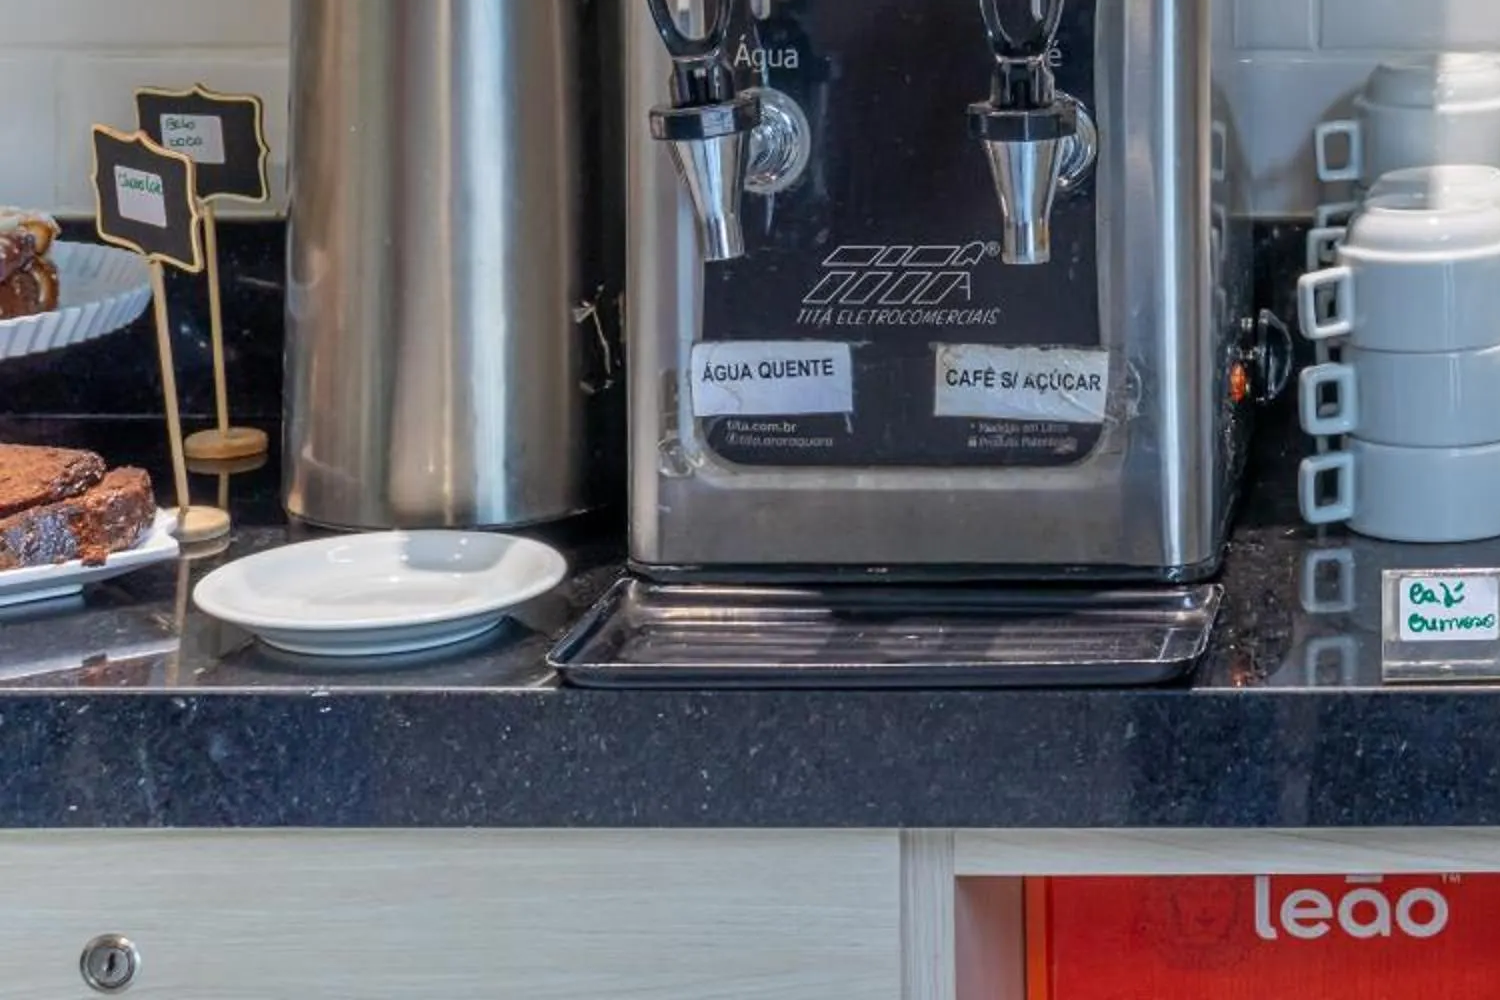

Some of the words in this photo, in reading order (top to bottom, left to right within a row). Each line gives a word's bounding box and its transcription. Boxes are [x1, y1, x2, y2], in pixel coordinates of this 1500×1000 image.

[733, 34, 799, 73] Água
[835, 307, 1001, 326] ELETROCOMERCIAIS
[702, 360, 753, 383] ÁGUA
[757, 358, 836, 379] QUENTE
[945, 366, 996, 388] CAFÉ
[1022, 368, 1101, 395] AÇÚCAR
